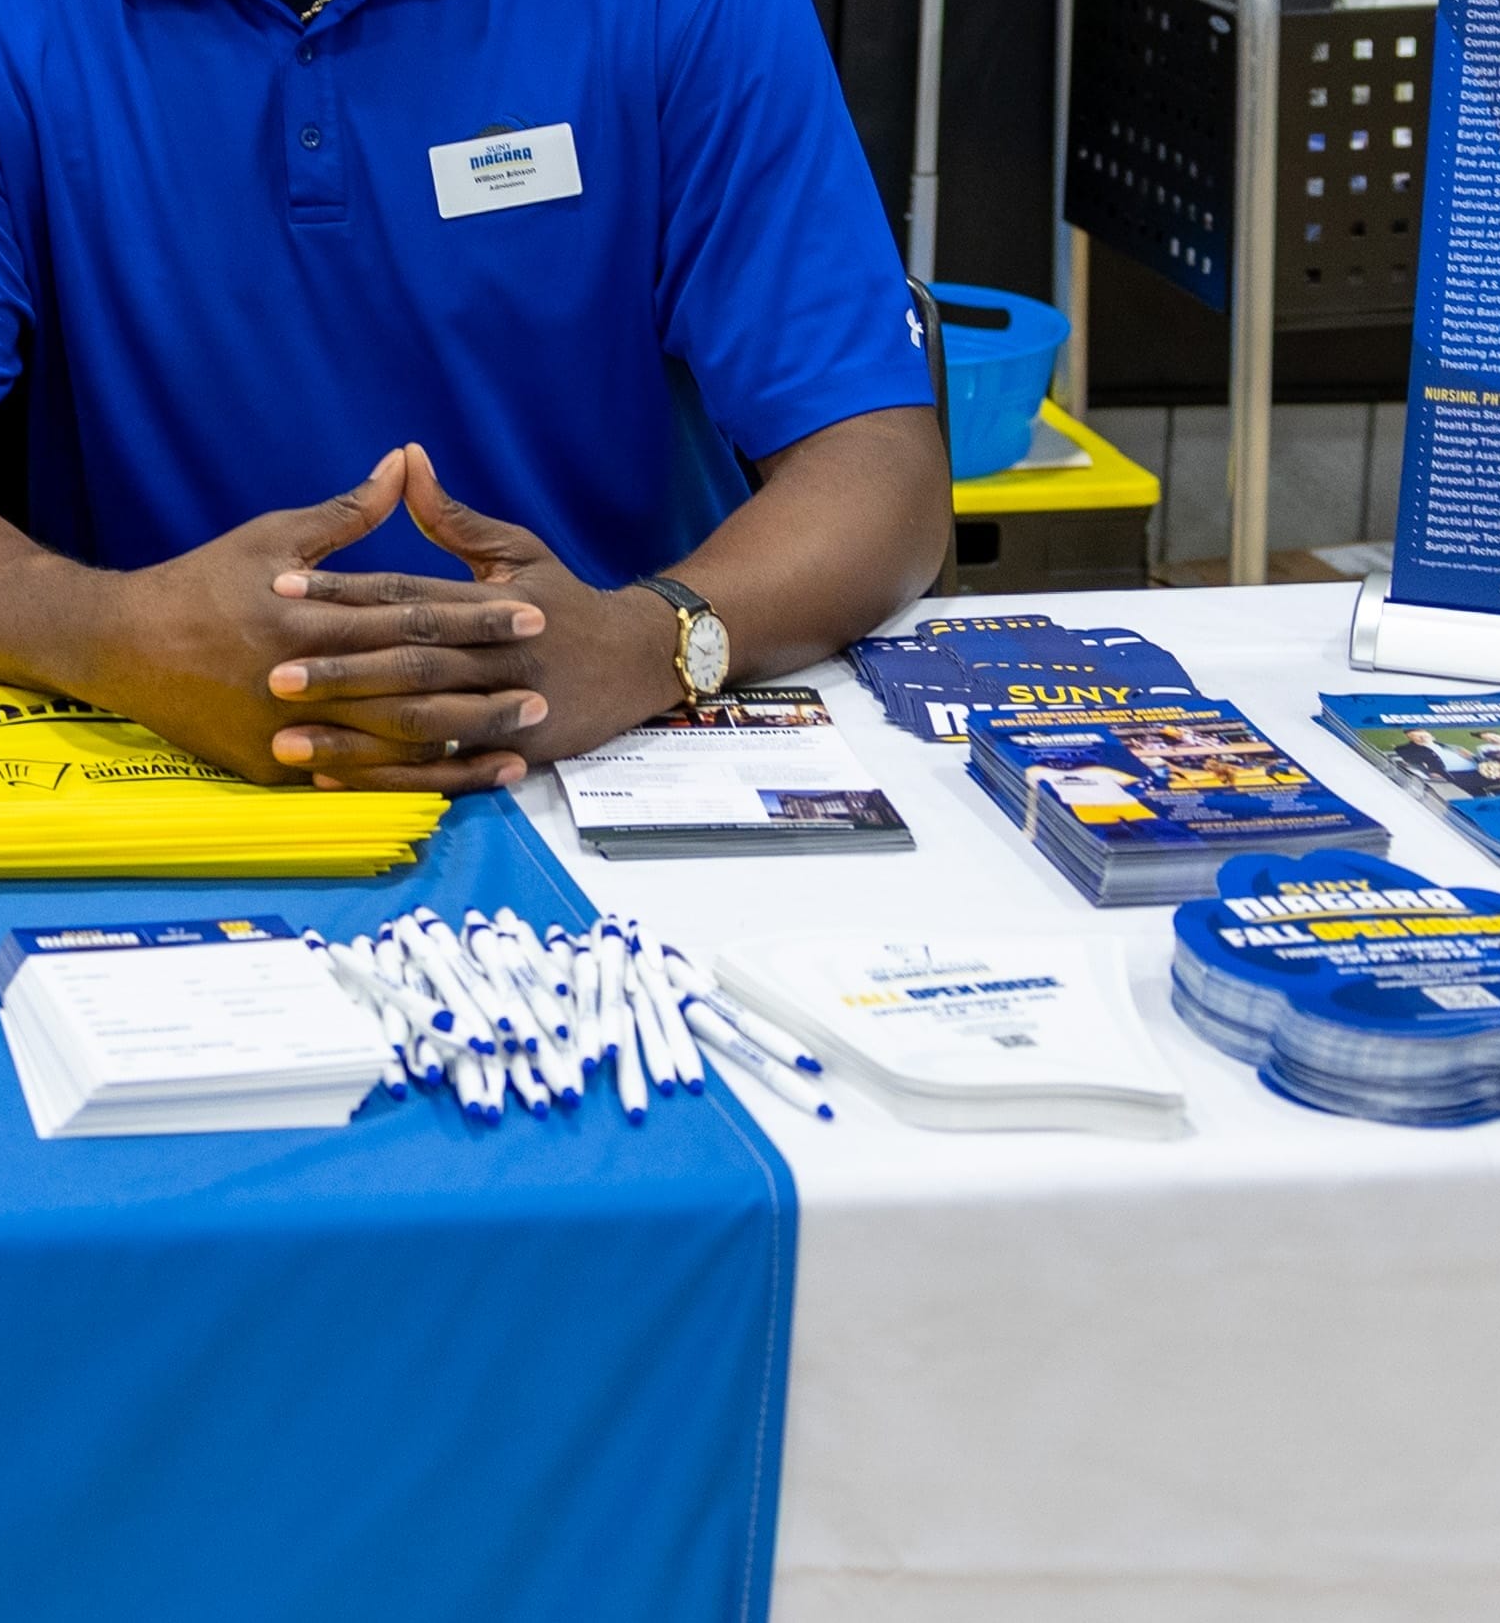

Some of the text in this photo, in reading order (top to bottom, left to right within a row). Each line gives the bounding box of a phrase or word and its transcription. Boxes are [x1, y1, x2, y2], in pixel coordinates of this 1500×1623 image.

[469, 147, 533, 171] NIAGARA
[1424, 386, 1481, 406] NURSING,
[738, 690, 812, 702] VILLAGE
[1007, 685, 1132, 705] SUNY
[84, 764, 191, 780] CULINARY
[1223, 888, 1468, 921] NIAGARA
[1219, 925, 1318, 948] FALL
[1307, 919, 1411, 942] OPEN
